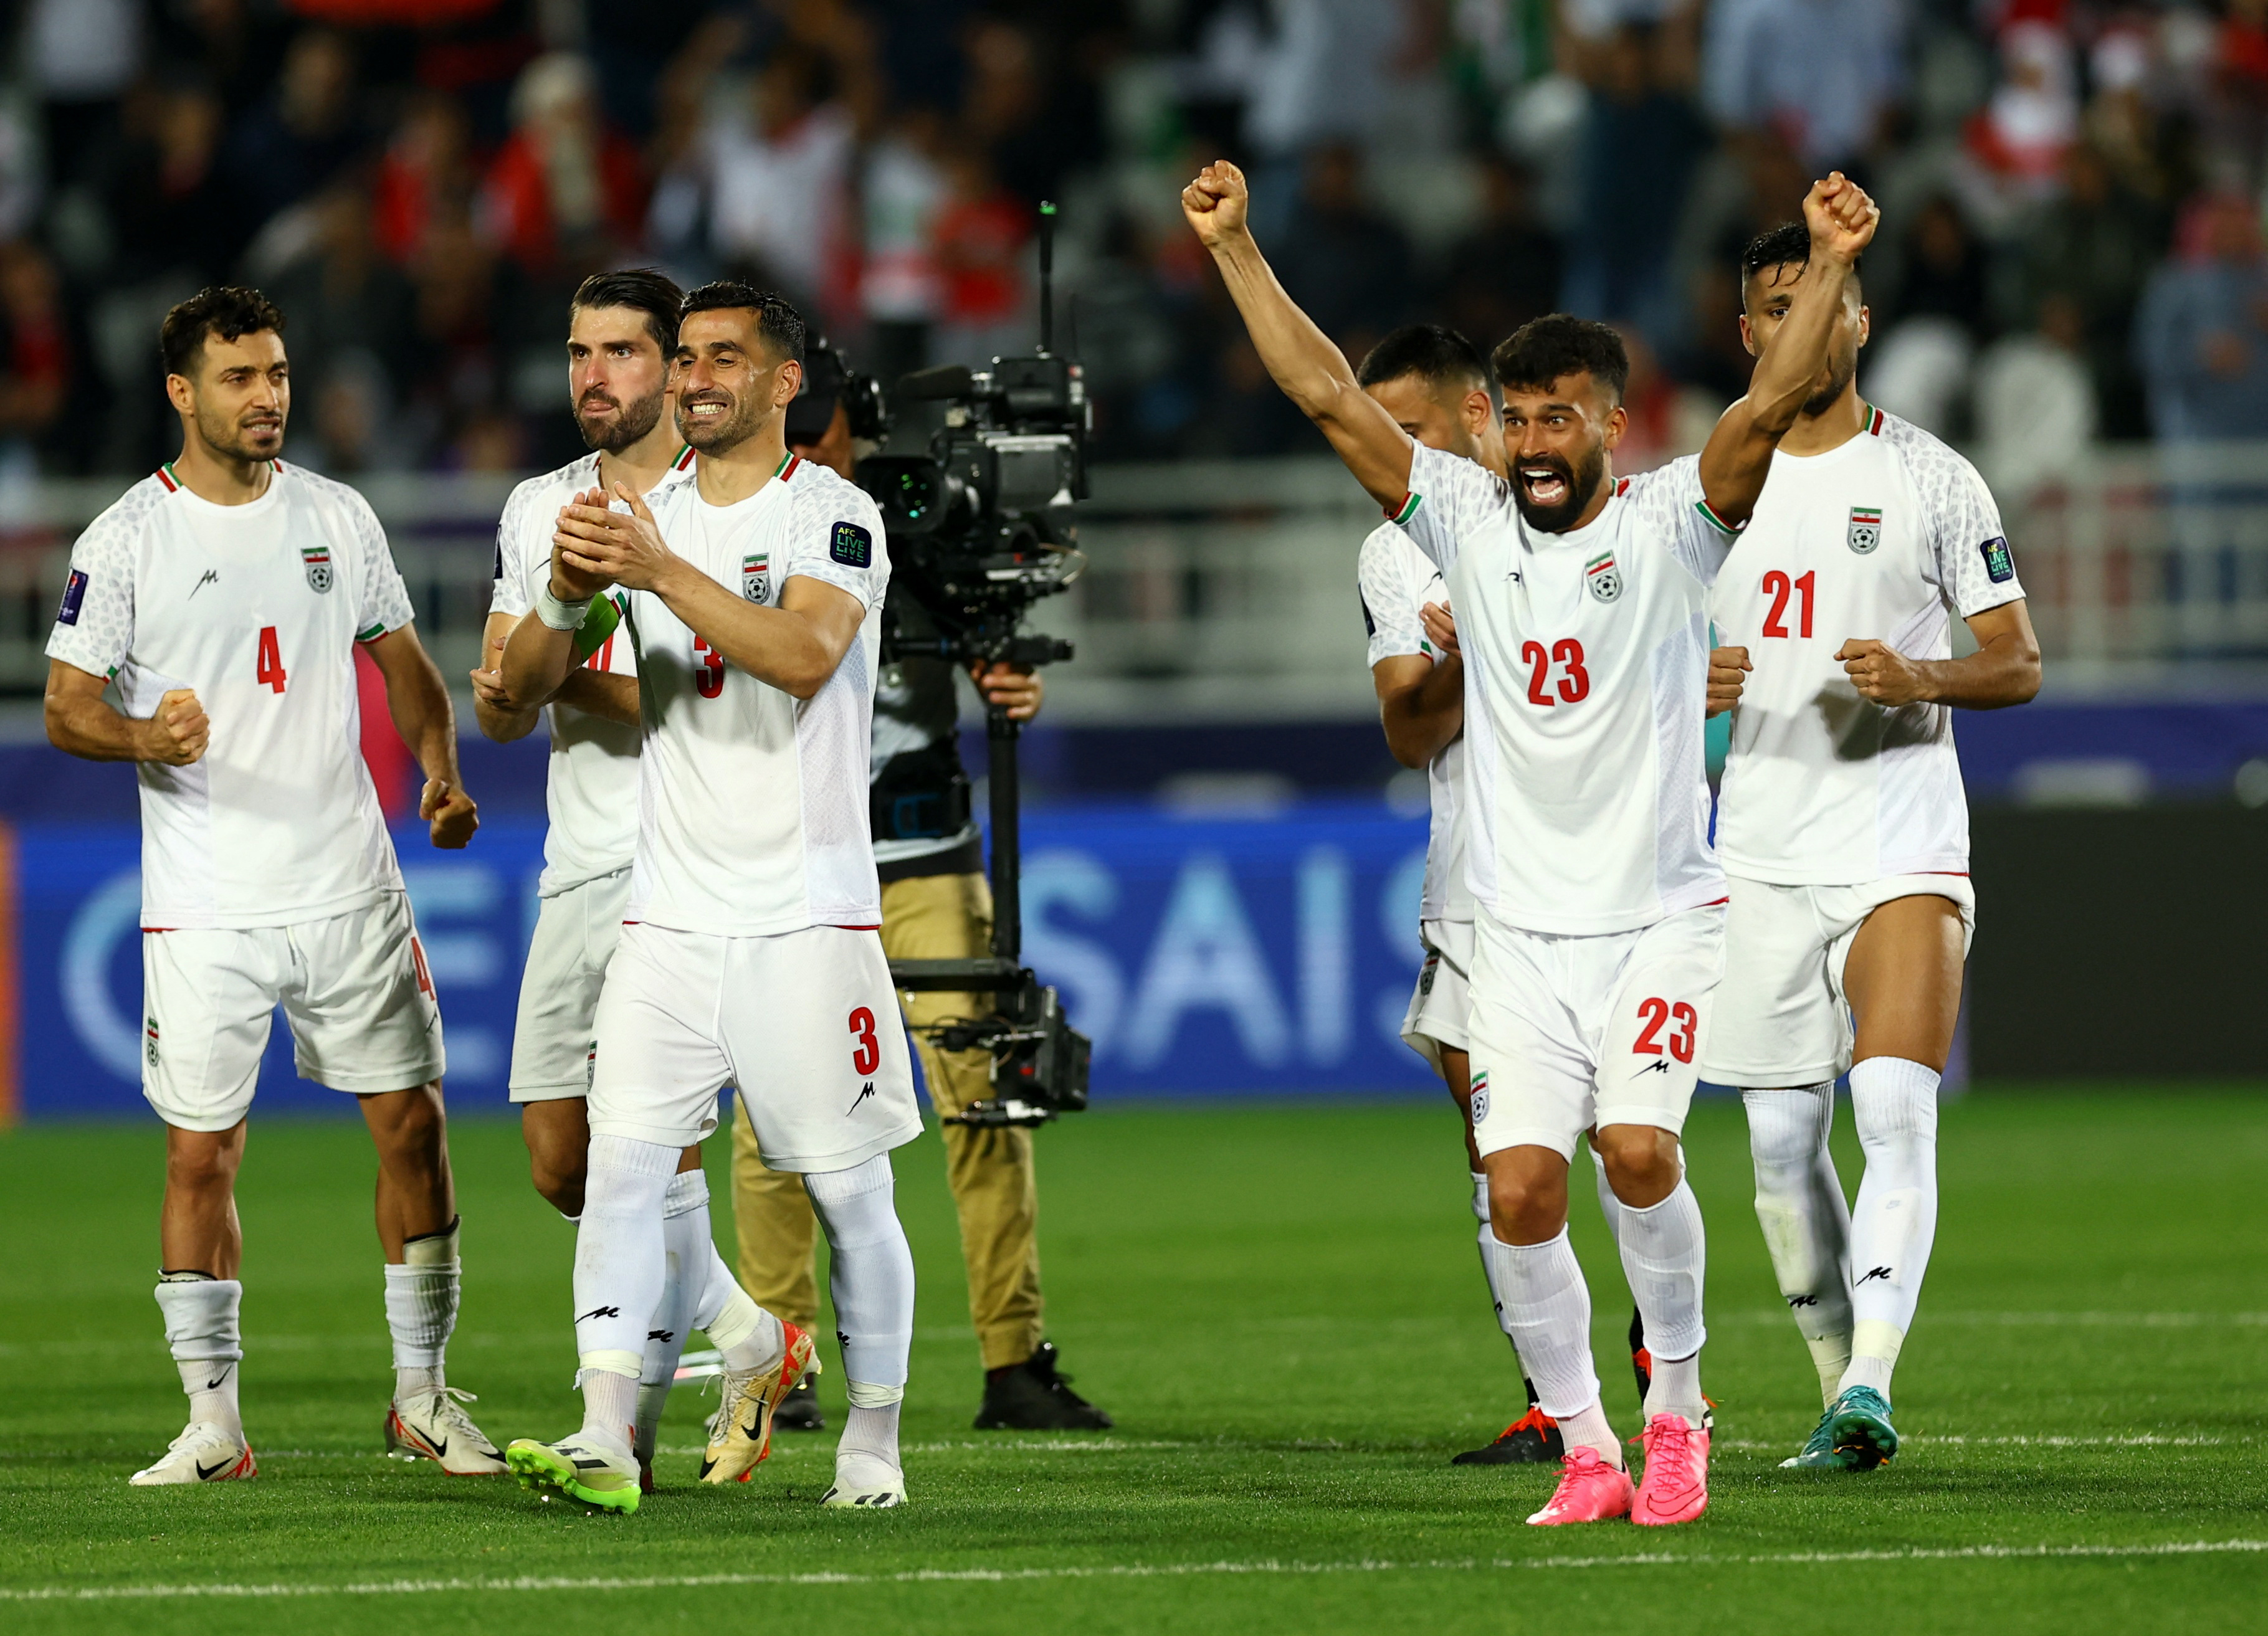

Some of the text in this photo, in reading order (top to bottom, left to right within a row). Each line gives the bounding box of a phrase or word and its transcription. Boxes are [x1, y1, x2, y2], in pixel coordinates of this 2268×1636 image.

[837, 534, 865, 552] LIVE
[838, 527, 855, 536] AFC
[1989, 549, 2007, 565] LIVE
[1762, 570, 1815, 639] 21
[257, 625, 287, 694] 4
[694, 633, 724, 699] 3
[1522, 637, 1589, 706] 23
[411, 936, 436, 1001] 4
[849, 1007, 880, 1076] 3
[1632, 997, 1697, 1064] 23
